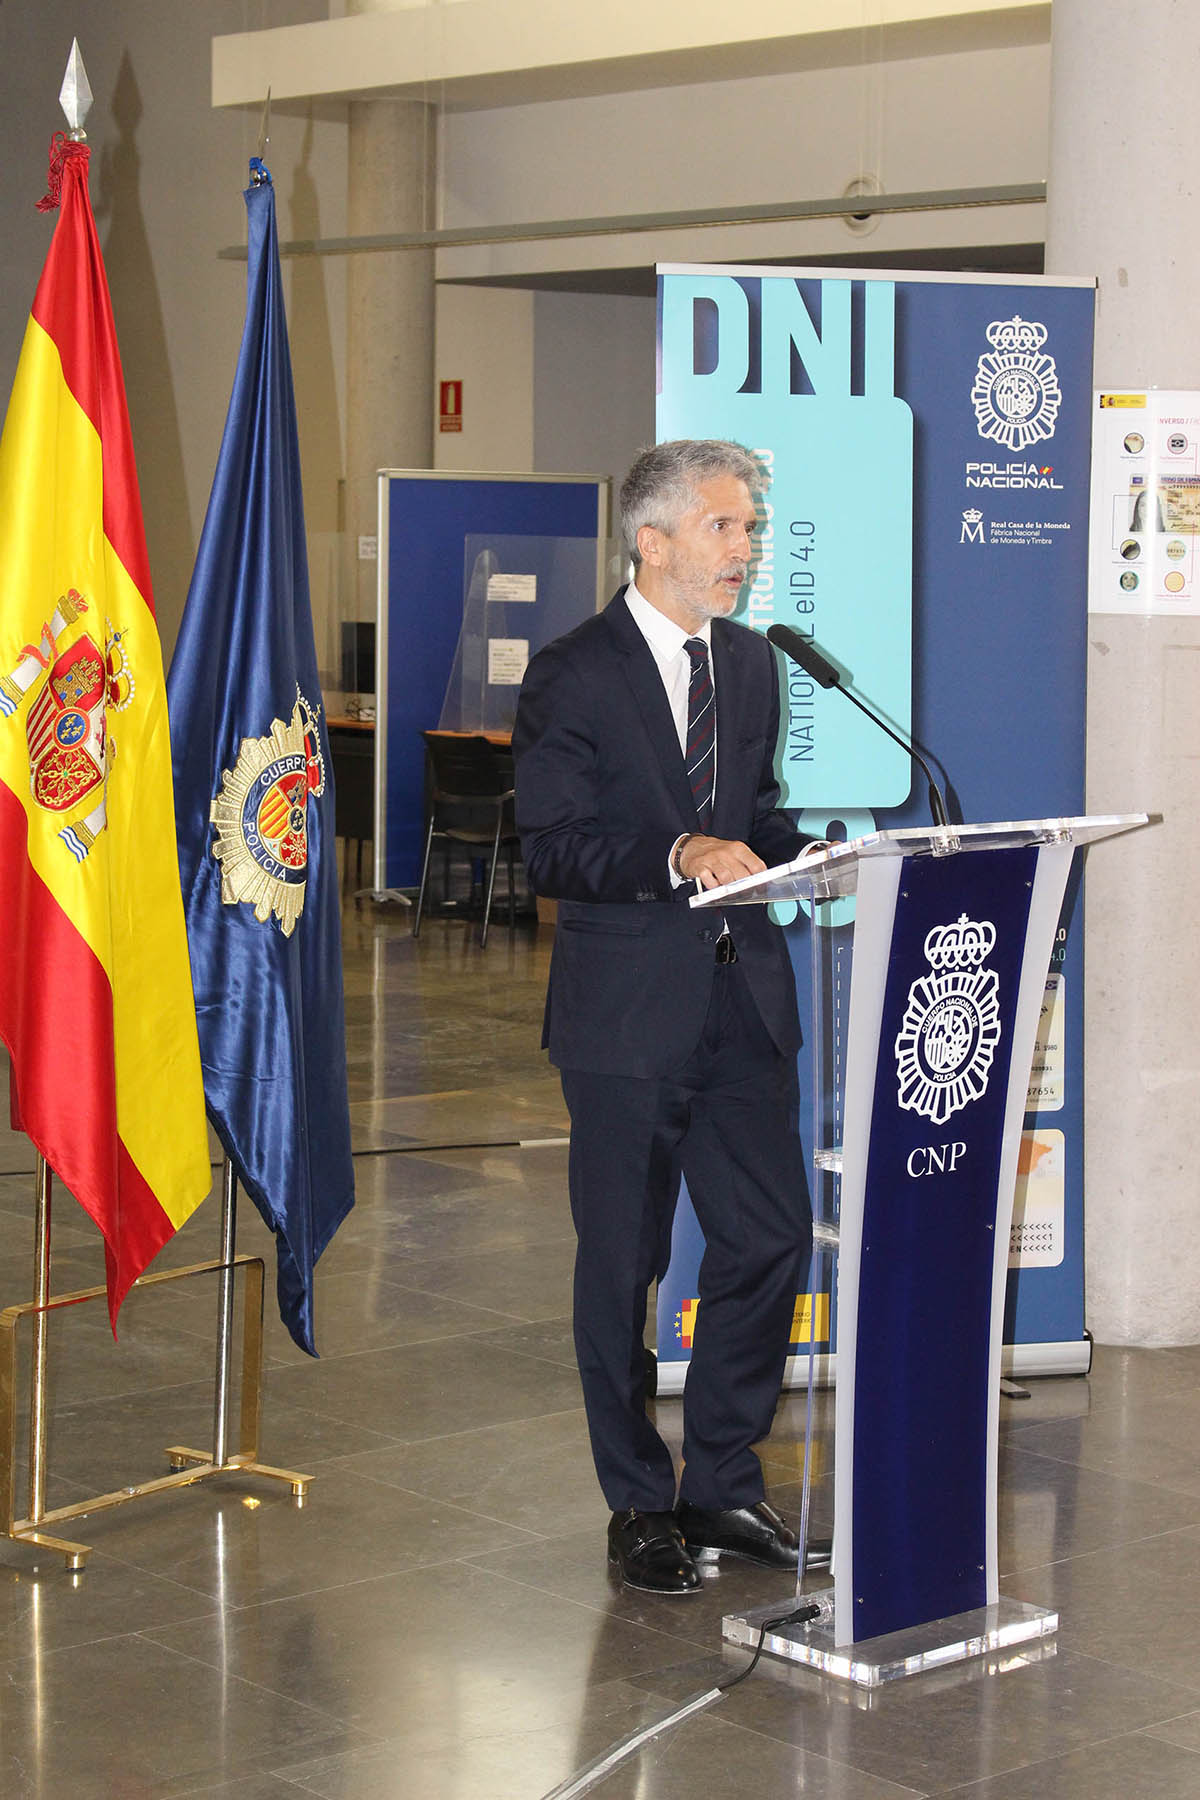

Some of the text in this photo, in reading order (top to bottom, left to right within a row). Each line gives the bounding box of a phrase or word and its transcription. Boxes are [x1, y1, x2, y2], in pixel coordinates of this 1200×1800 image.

[660, 275, 895, 396] DNI
[965, 461, 1039, 475] POLICÍA
[965, 476, 1064, 489] NACIONAL
[790, 520, 815, 562] 4.0
[991, 521, 1006, 529] Real
[1008, 521, 1024, 529] Casa
[1025, 521, 1035, 529] de
[1036, 521, 1042, 529] la
[790, 571, 815, 614] eID
[260, 756, 307, 787] CUERPO
[243, 821, 287, 881] POLICIA
[921, 1001, 946, 1034] CUERPO
[945, 997, 973, 1018] NACIONAL
[932, 1071, 957, 1082] POLICIA
[906, 1141, 967, 1178] CNP
